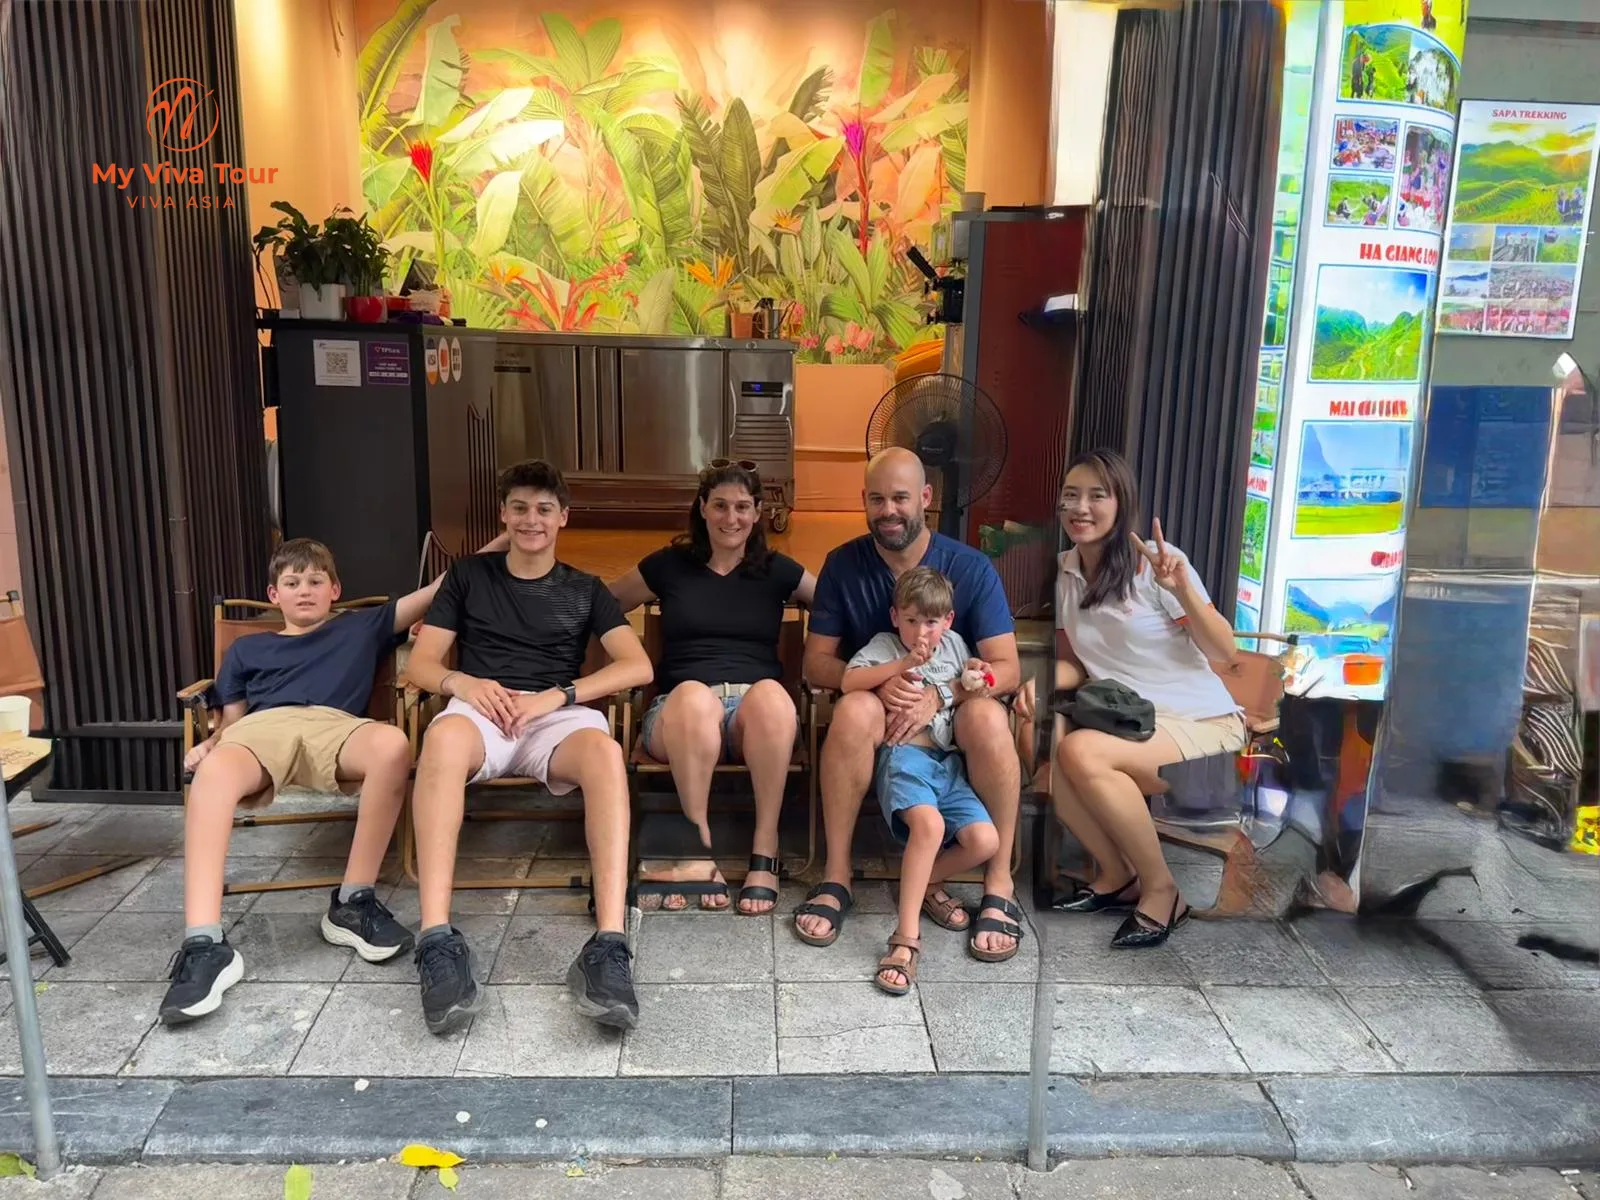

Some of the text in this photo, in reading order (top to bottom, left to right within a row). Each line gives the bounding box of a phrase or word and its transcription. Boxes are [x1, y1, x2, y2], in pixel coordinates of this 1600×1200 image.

[1492, 109, 1567, 120] SAPA TREKKING
[1360, 243, 1382, 261] HA
[1385, 245, 1423, 264] GIANG
[1329, 400, 1356, 417] MAI
